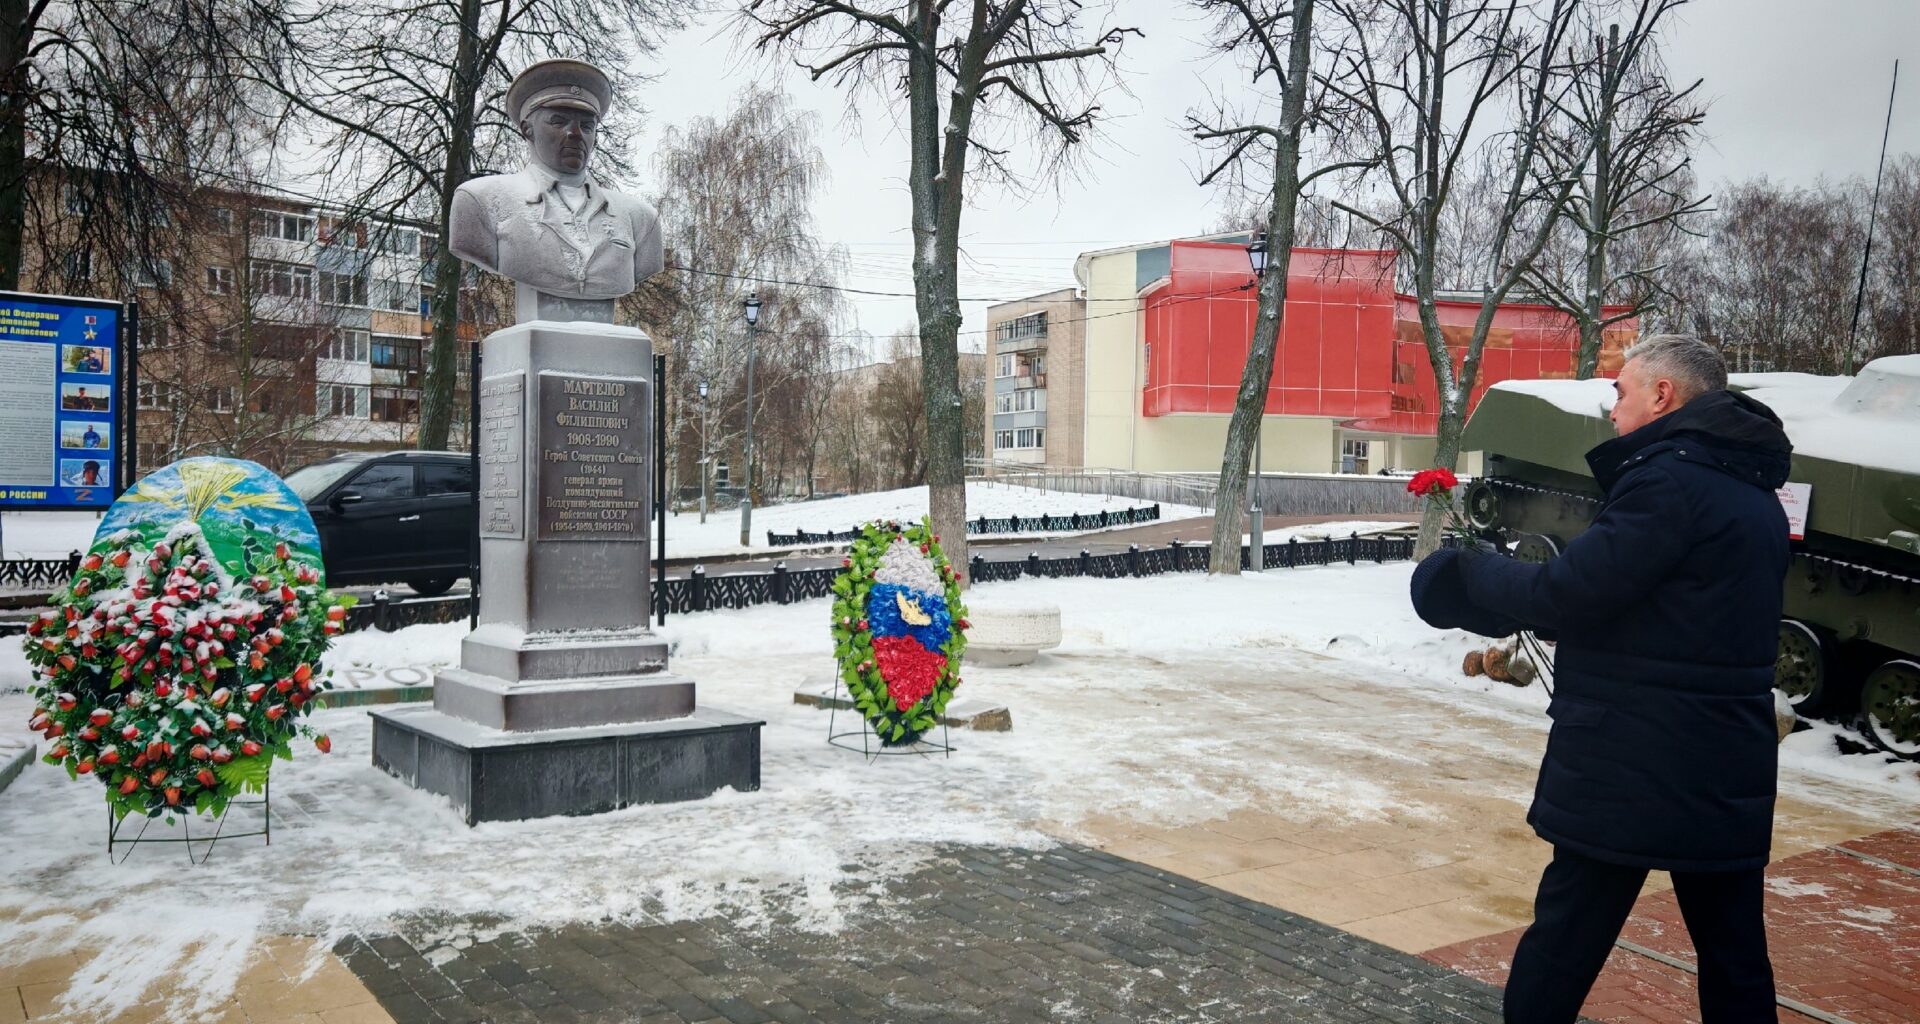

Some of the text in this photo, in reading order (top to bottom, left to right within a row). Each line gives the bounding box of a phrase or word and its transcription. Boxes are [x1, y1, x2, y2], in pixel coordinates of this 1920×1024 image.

[13, 309, 60, 321] Федерации
[563, 380, 626, 396] МАРГЕЛОВ
[567, 432, 620, 447] 1908-1990
[544, 449, 643, 464] Герой Советского Союза
[580, 463, 606, 475] (1944)
[563, 476, 624, 487] генерал армии
[9, 490, 47, 500] РОССИИ!
[565, 487, 624, 499] командующий
[546, 496, 640, 509] Воздушно-десантными
[559, 509, 628, 520] войсками СССР
